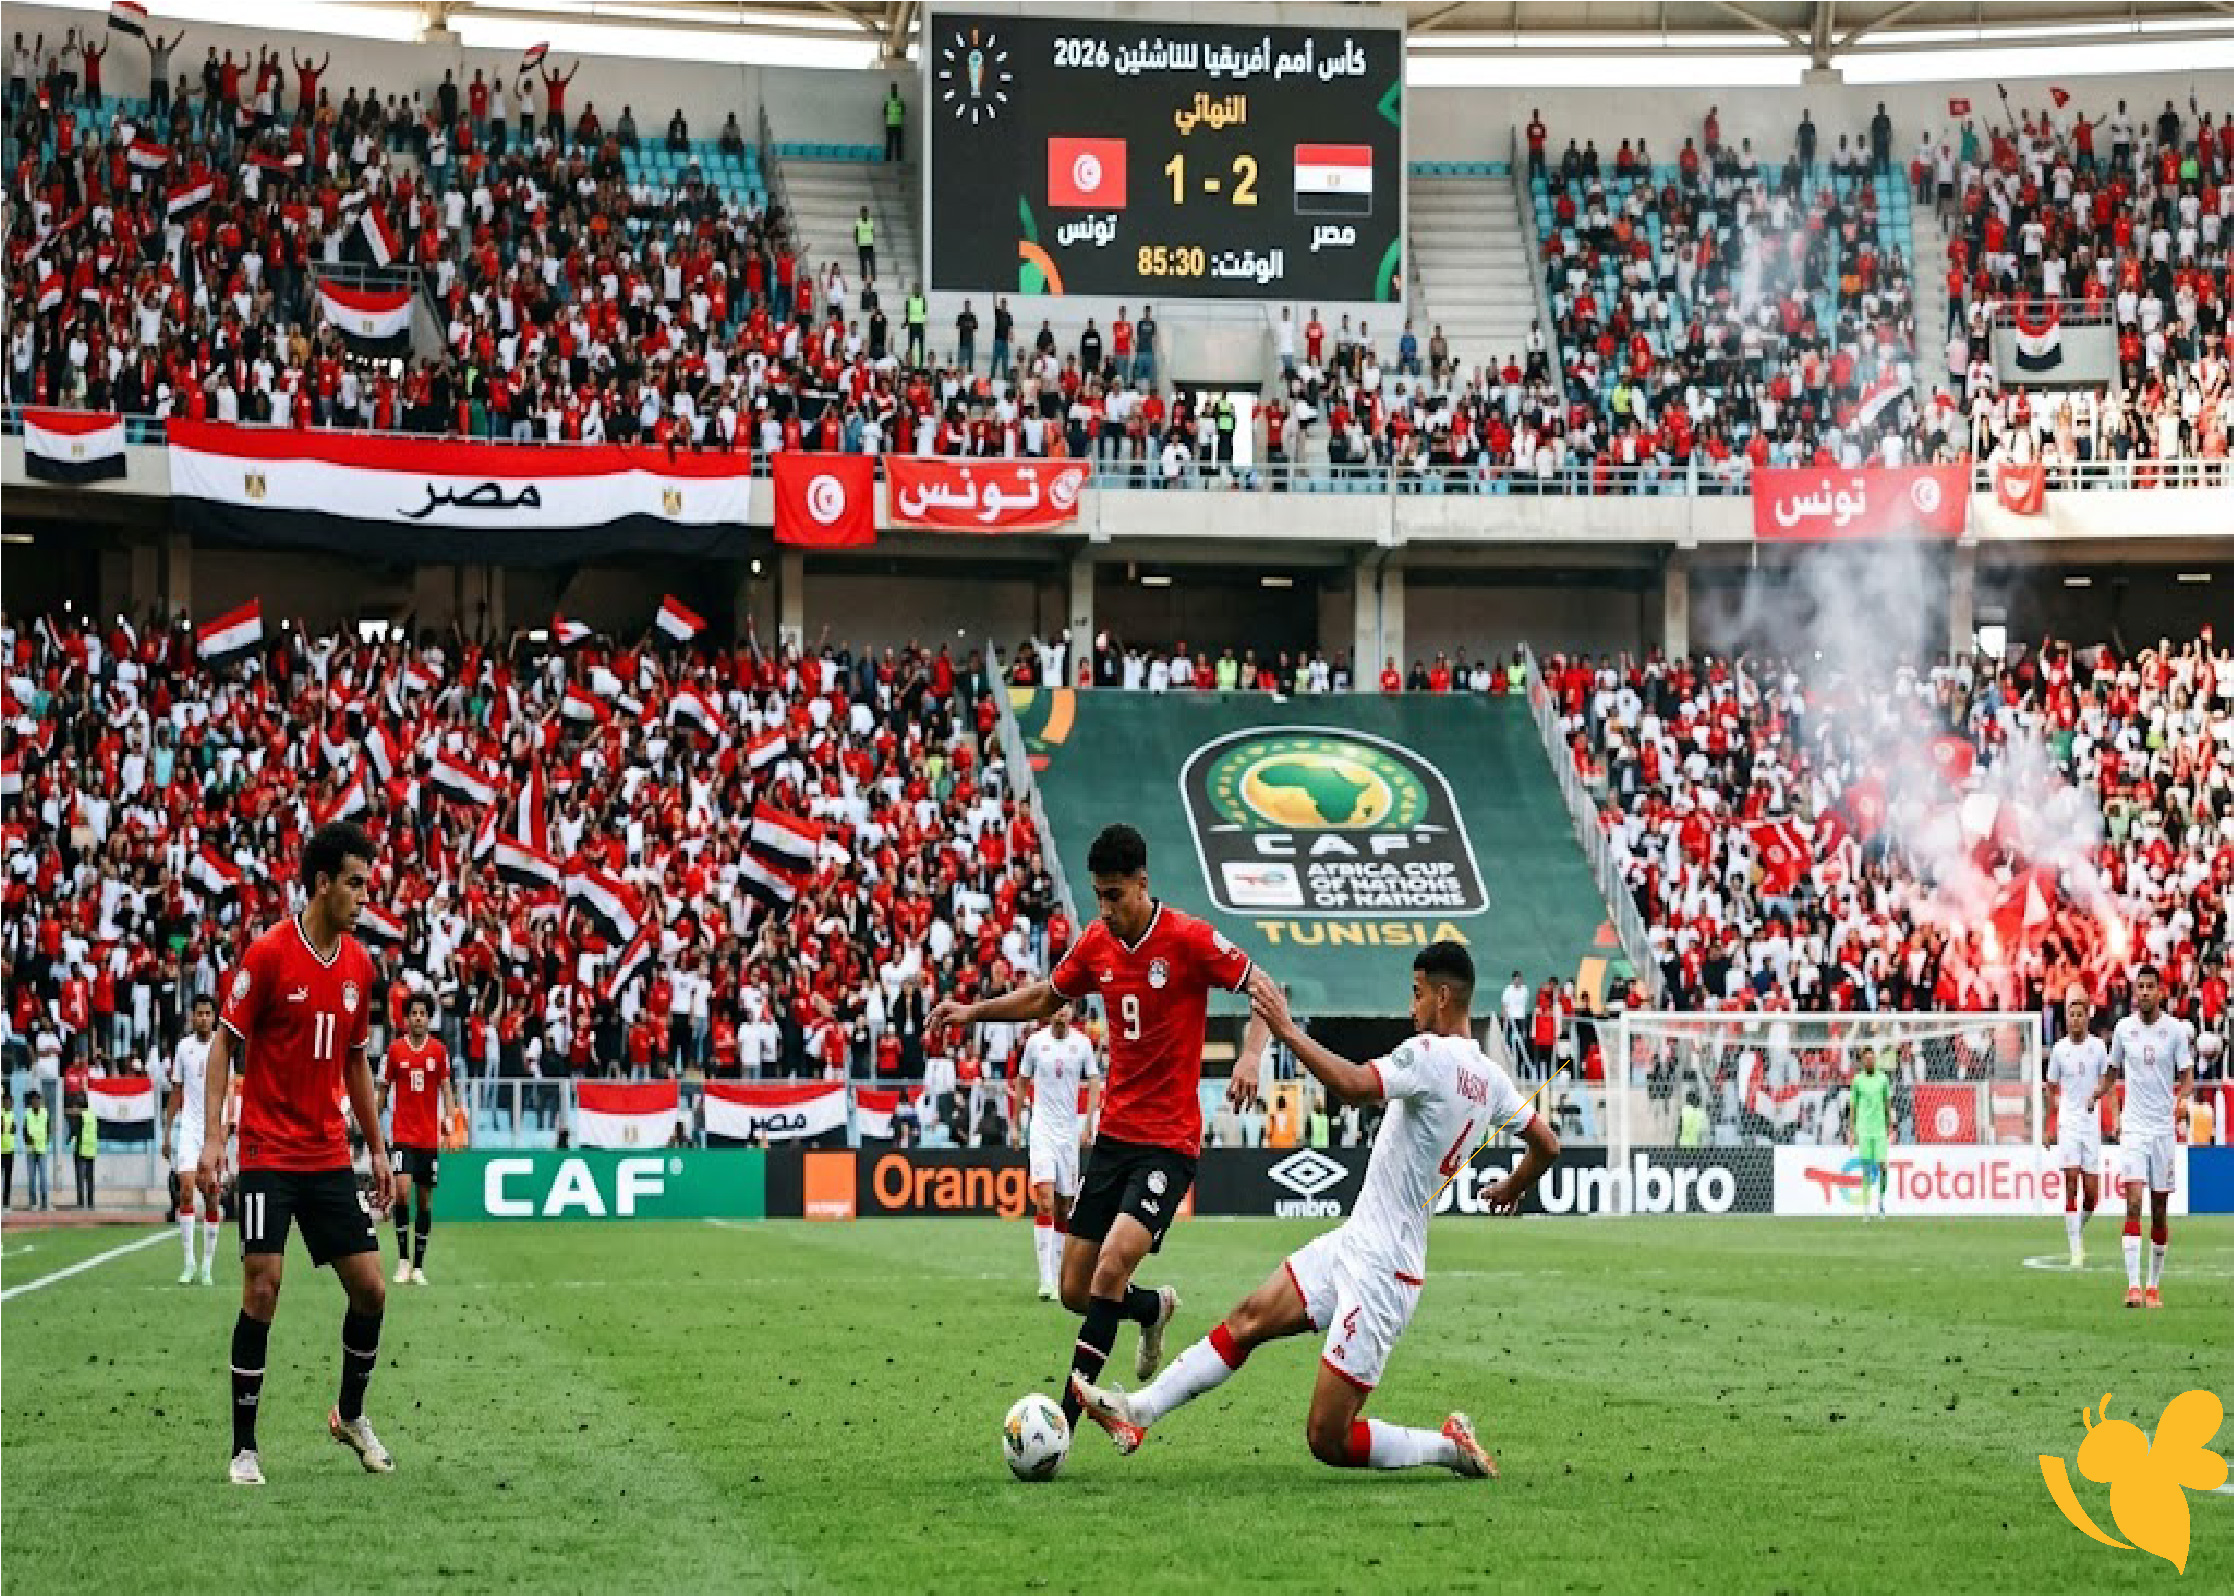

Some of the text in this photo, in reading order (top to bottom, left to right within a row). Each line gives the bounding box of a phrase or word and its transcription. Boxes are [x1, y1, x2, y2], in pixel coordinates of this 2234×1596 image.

[1053, 38, 1110, 69] 2026
[1274, 37, 1314, 79] أمم
[1318, 38, 1366, 80] كأس
[1175, 93, 1247, 134] النهائي
[1164, 153, 1184, 205] 1
[1232, 154, 1259, 205] 2
[1057, 215, 1118, 246] تونس
[1311, 225, 1355, 252] مصر
[1138, 246, 1205, 276] 85:30
[397, 480, 542, 518] مصر
[899, 467, 1040, 522] تونس
[1775, 476, 1866, 527] تونس
[1255, 921, 1471, 945] TUNISIA
[313, 1011, 335, 1059] 11
[1121, 994, 1141, 1040] 9
[749, 1113, 807, 1136] مصر
[873, 1152, 1038, 1217] Orang
[1538, 1152, 1735, 1214] umbro
[243, 1191, 266, 1240] 11
[1275, 1195, 1341, 1217] umbro
